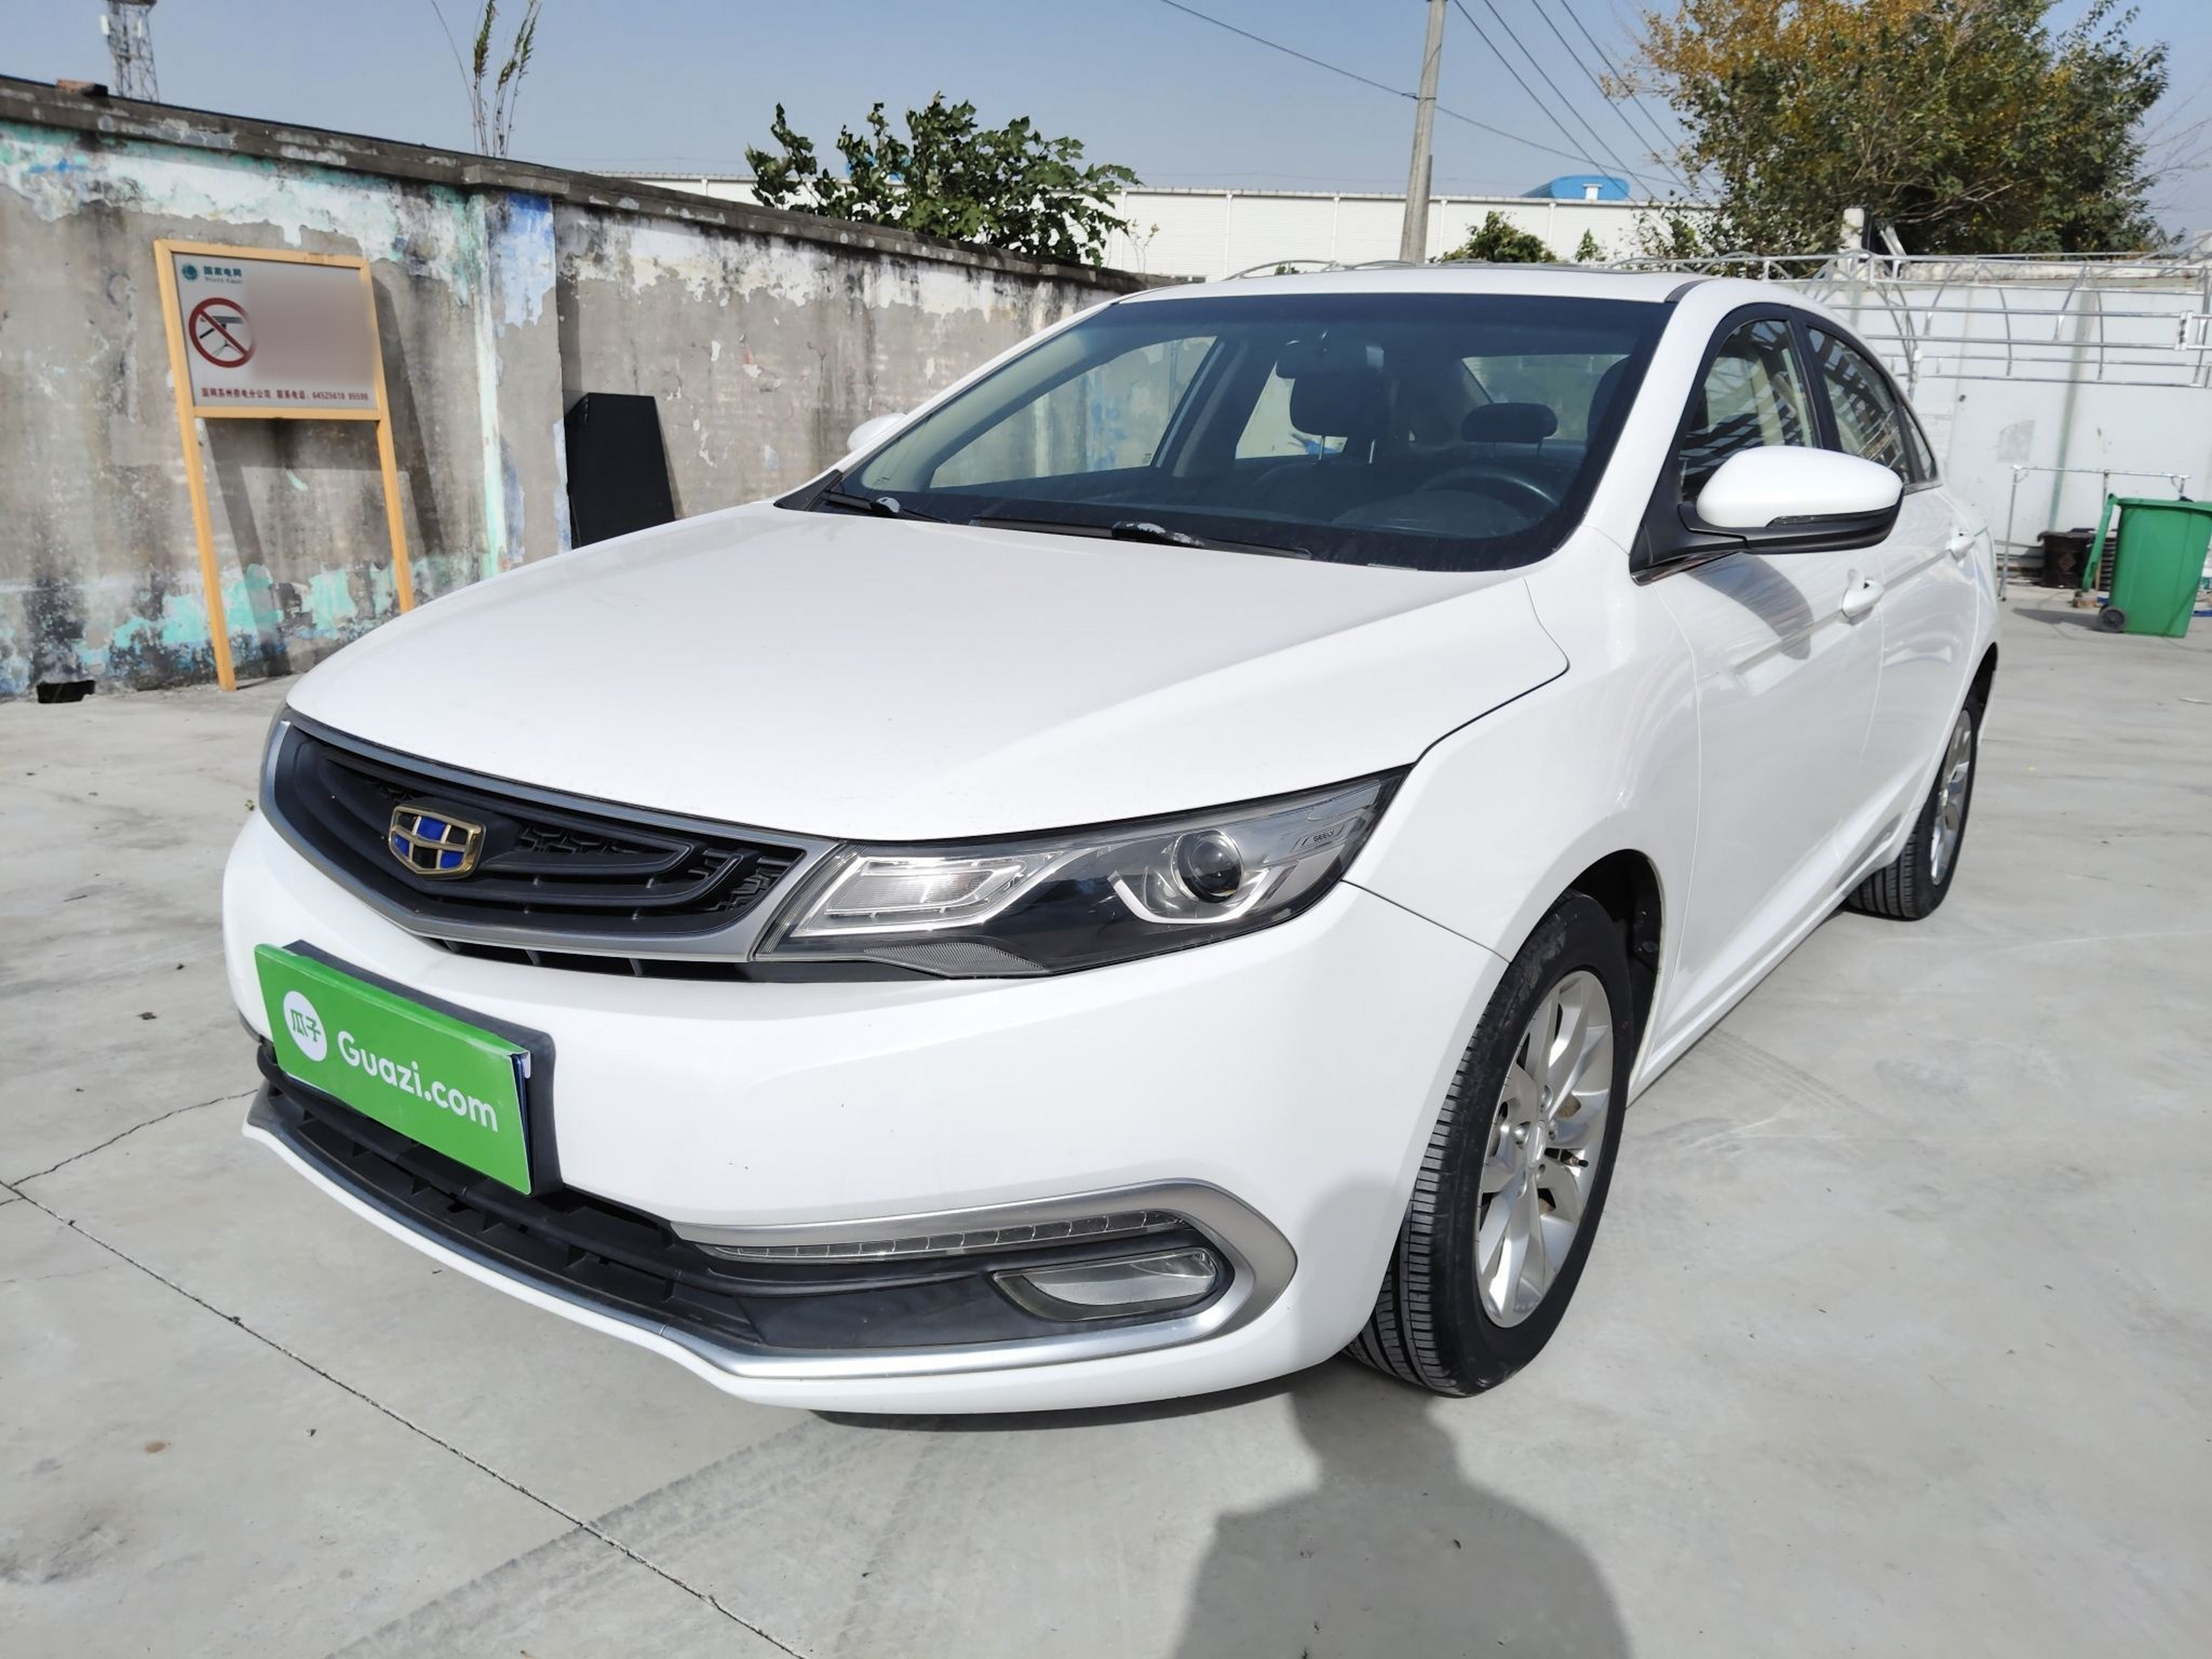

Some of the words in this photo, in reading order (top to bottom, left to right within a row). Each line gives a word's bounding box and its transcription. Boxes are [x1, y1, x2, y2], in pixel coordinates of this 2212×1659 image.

[203, 266, 242, 277] 国家电网
[1313, 830, 1335, 842] GEELY
[290, 1009, 321, 1043] 瓜子
[338, 1031, 498, 1132] Guazi.com
